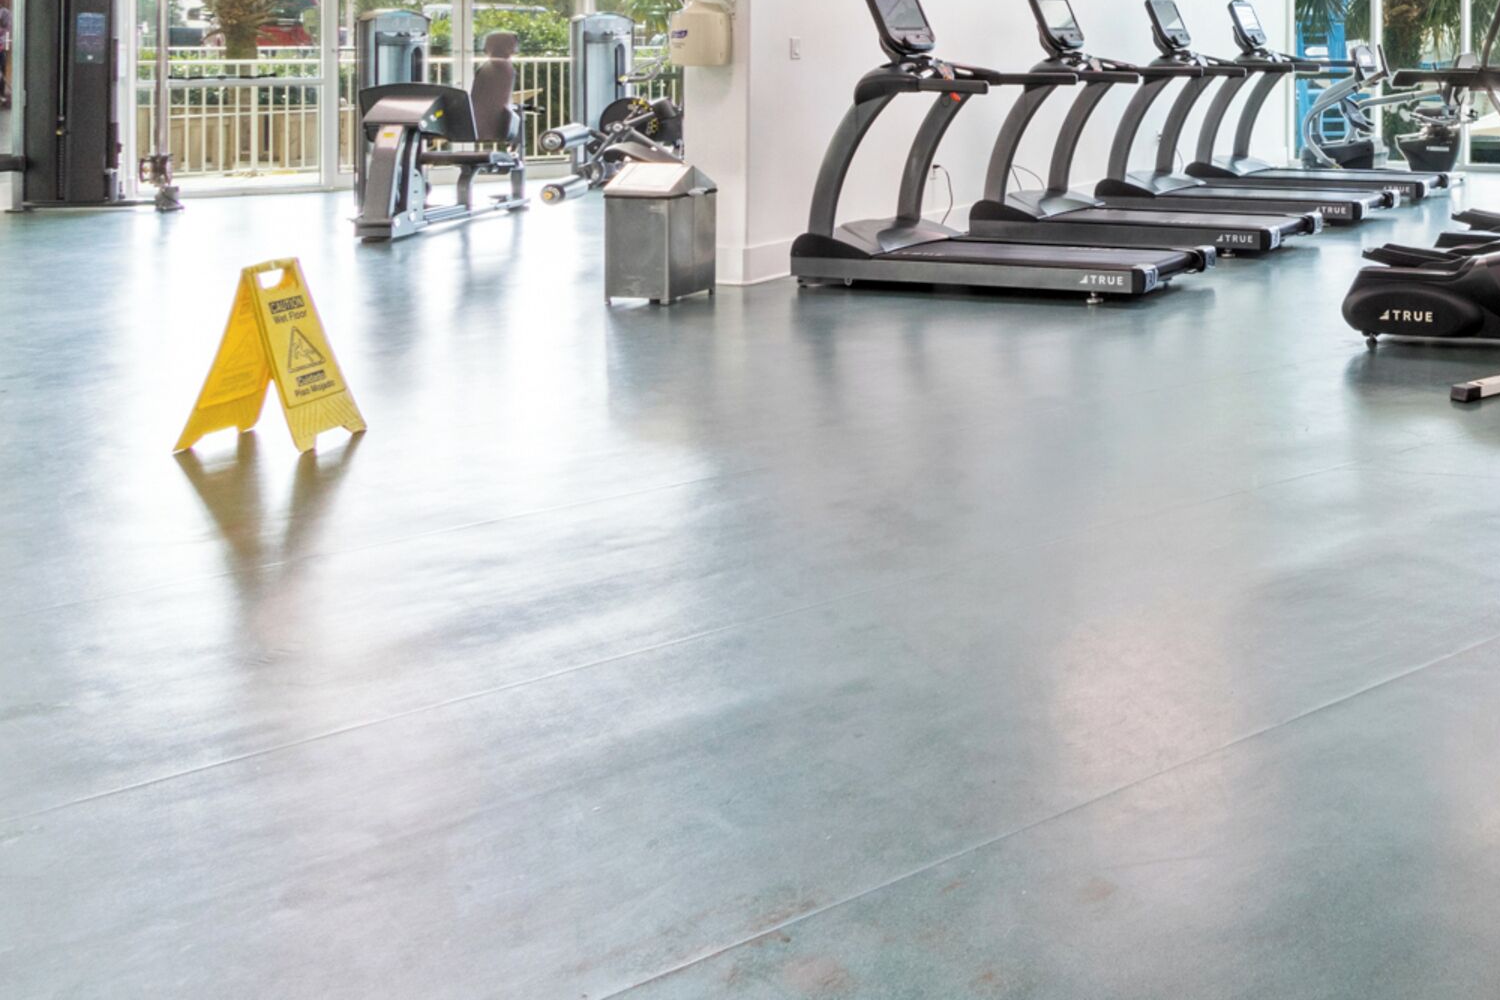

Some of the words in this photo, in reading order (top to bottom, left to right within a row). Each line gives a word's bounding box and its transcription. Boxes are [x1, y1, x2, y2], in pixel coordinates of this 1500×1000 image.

[1321, 206, 1346, 215] TRUE
[1224, 234, 1253, 243] TRUE
[1090, 275, 1123, 285] TRUE
[1392, 309, 1433, 322] TRUE
